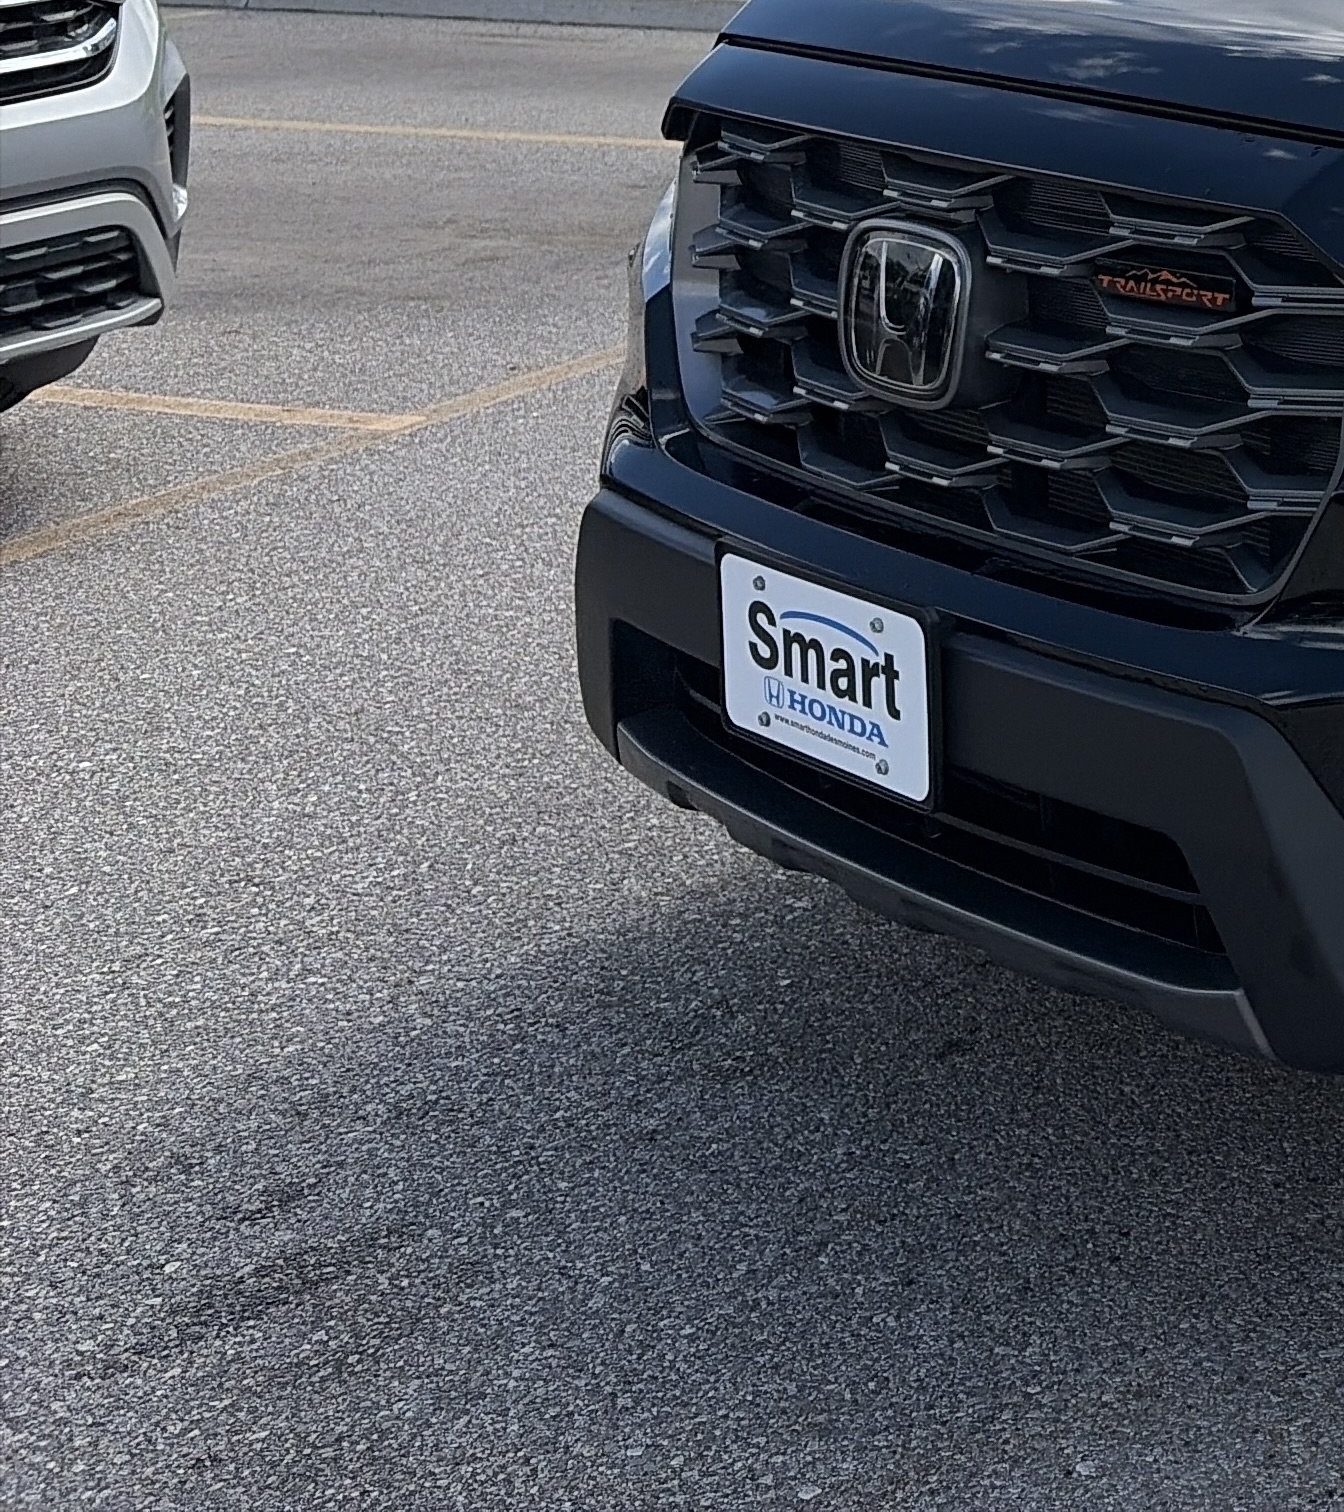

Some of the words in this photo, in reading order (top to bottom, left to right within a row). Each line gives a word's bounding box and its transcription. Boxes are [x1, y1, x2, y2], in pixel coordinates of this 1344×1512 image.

[1098, 274, 1231, 308] TRAILSPORT
[748, 600, 901, 721] Smart
[774, 713, 877, 761] www.smarthondadesmoines.com
[787, 688, 889, 748] HONDA
